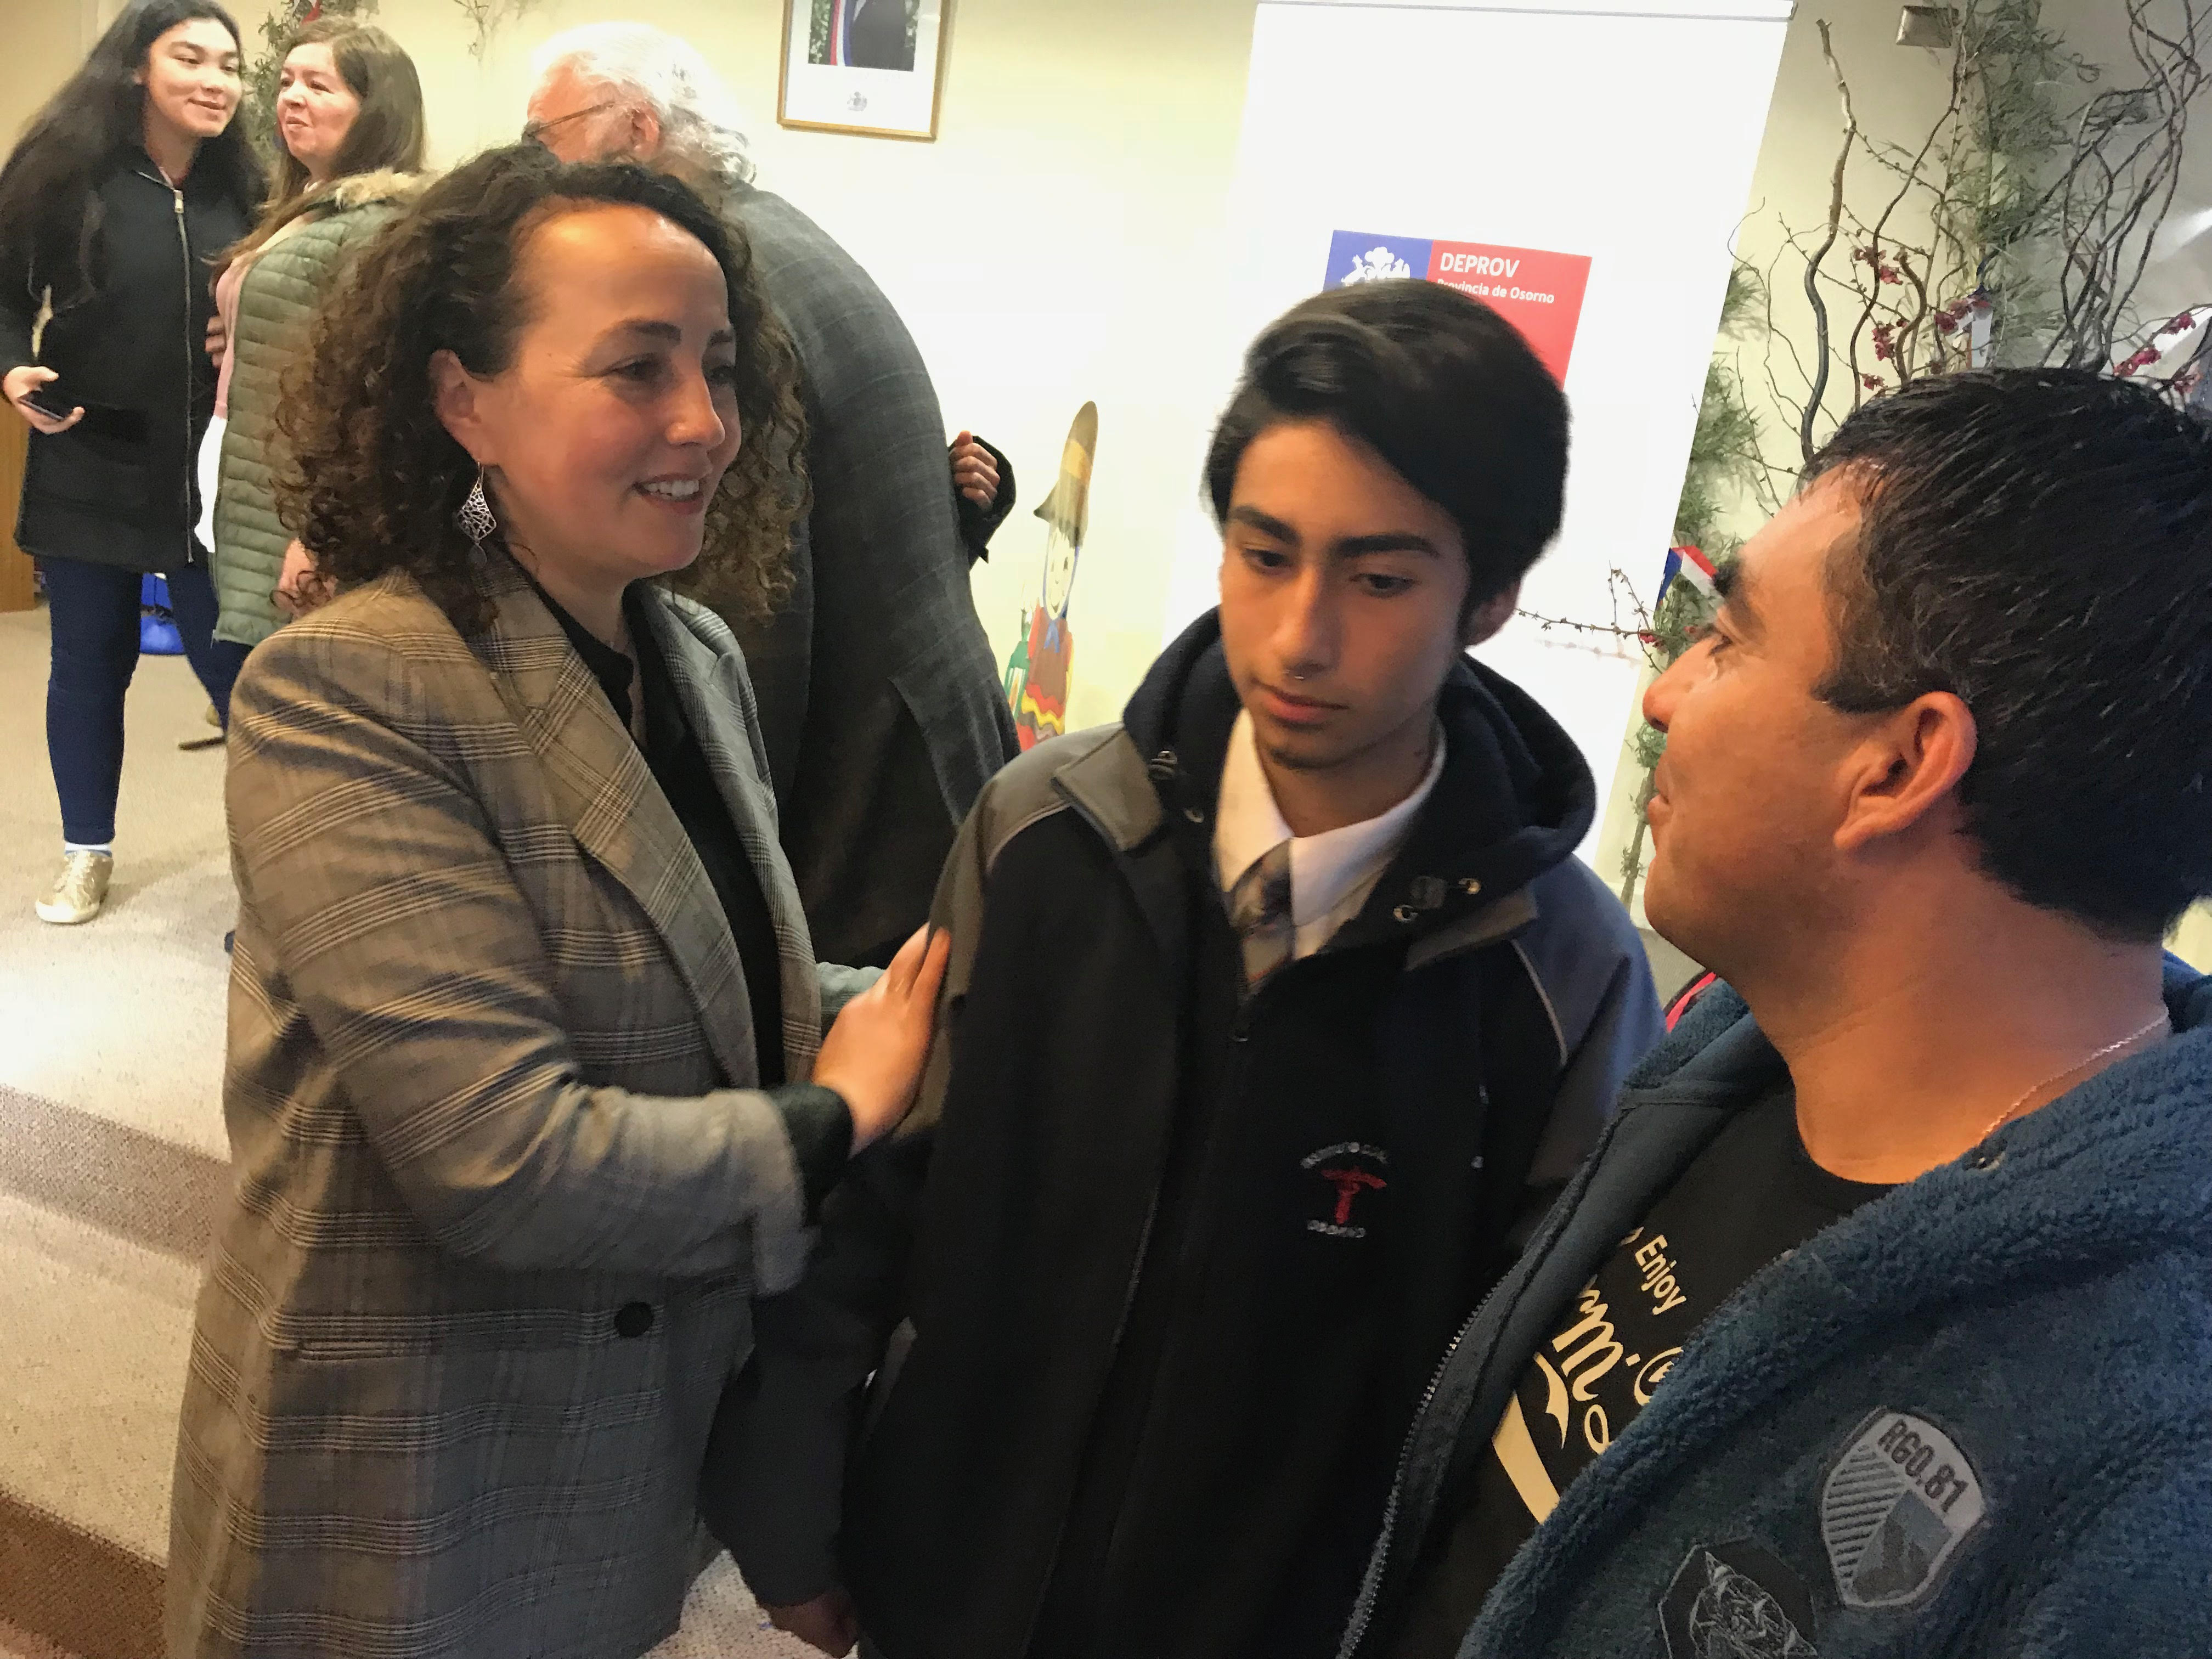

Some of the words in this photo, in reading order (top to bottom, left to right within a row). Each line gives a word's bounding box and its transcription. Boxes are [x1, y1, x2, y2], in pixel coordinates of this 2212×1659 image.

[1440, 252, 1520, 278] DEPROV
[1492, 285, 1507, 297] de
[1510, 287, 1555, 303] Osorno
[1635, 1234, 1687, 1315] Enjoy
